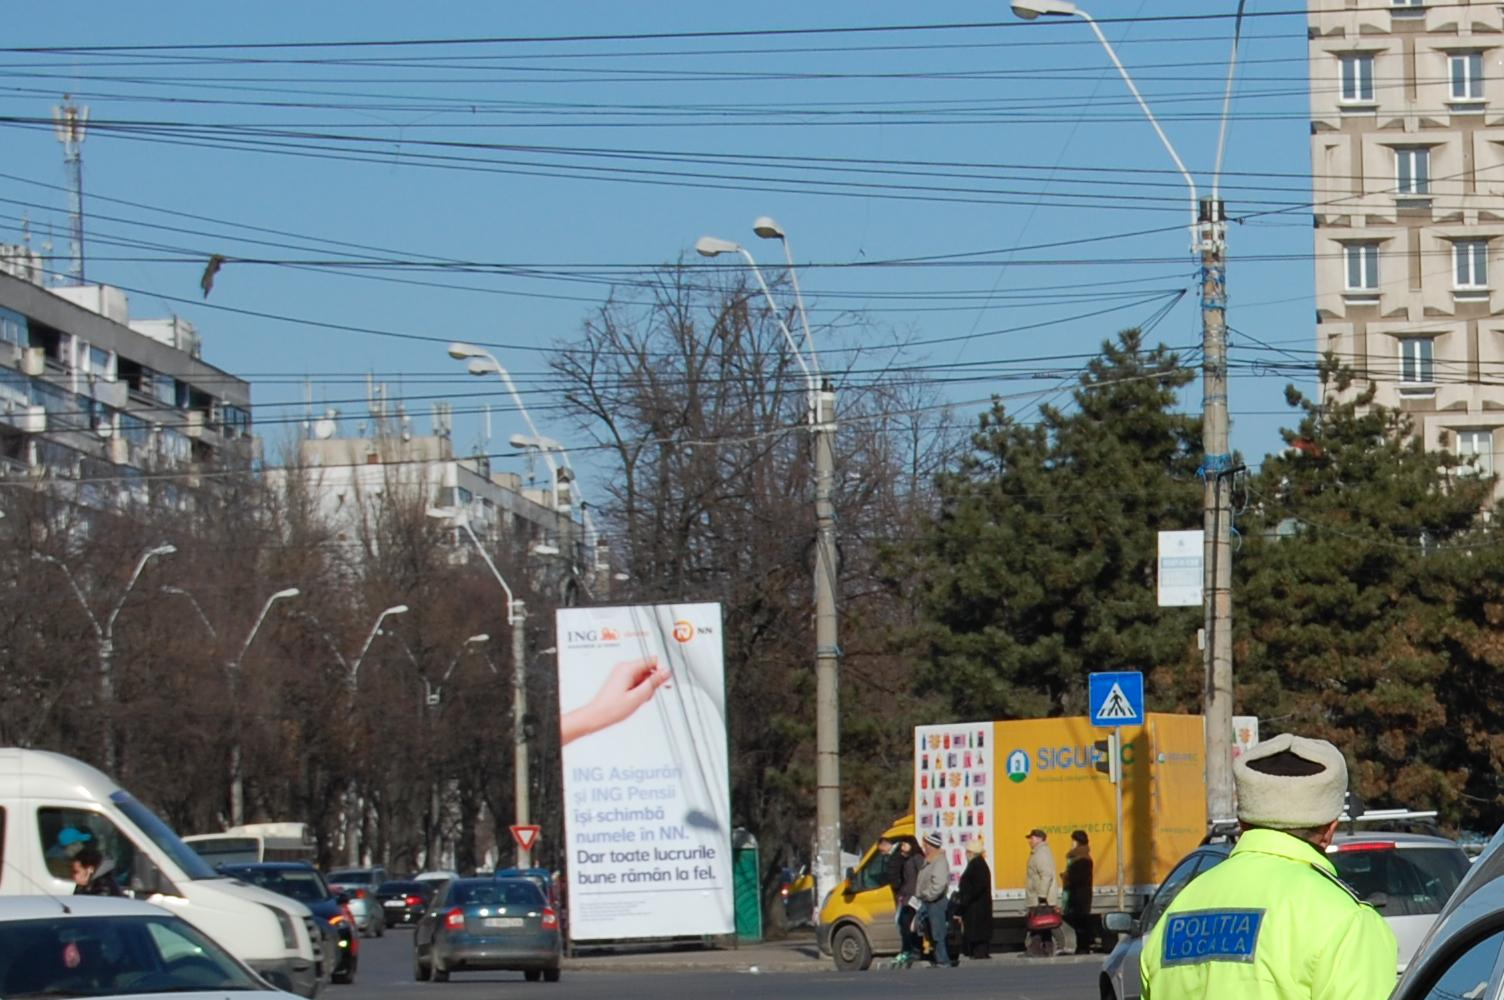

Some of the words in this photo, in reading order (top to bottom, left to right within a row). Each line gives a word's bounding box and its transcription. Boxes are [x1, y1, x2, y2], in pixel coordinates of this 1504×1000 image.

[568, 630, 597, 641] ING
[573, 767, 603, 782] ING
[592, 787, 622, 802] ING
[628, 785, 676, 800] Pensii
[576, 828, 635, 844] numele
[659, 825, 689, 841] NN.
[577, 849, 605, 864] Dar
[610, 849, 650, 863] toate
[654, 845, 716, 861] lucrurile
[578, 870, 616, 884] bune
[676, 866, 689, 881] la
[693, 865, 716, 881] fel.
[1169, 937, 1246, 956] LOCALA
